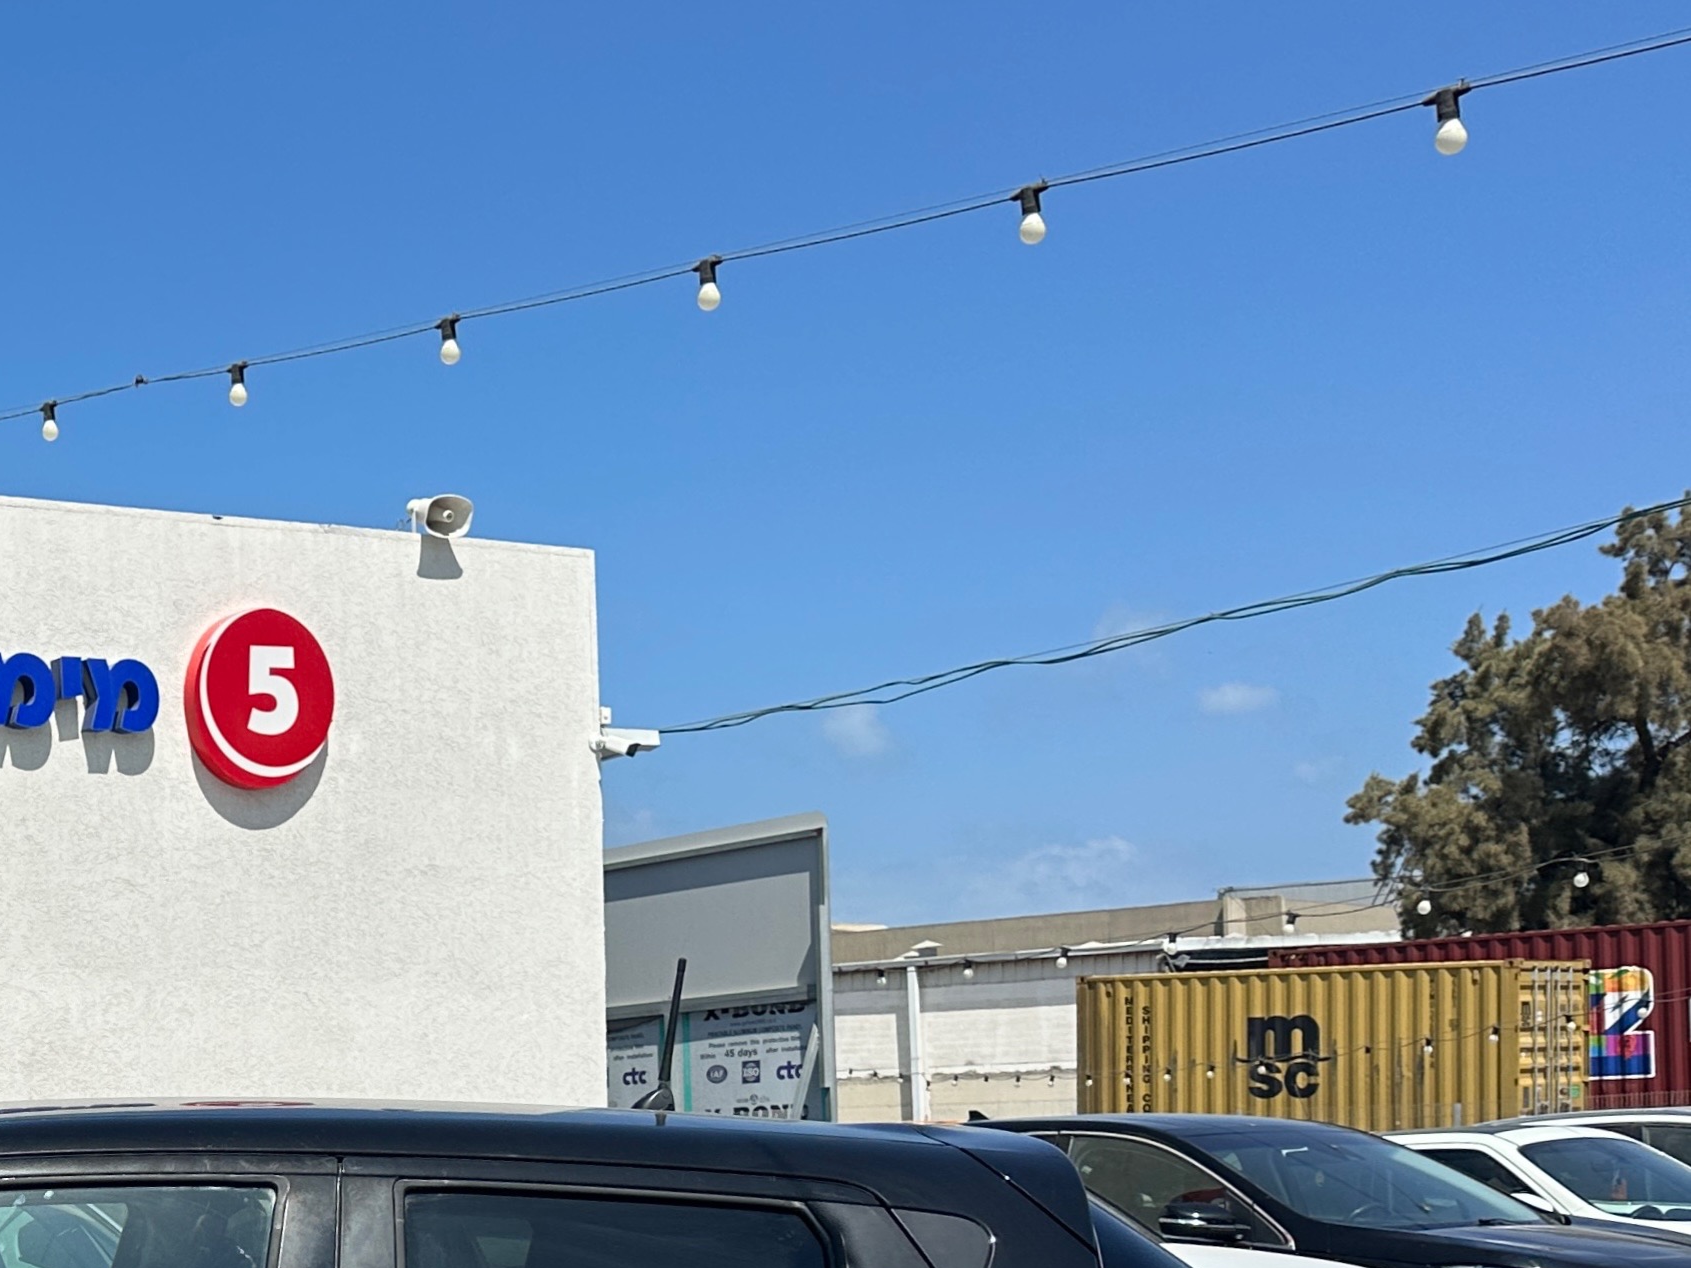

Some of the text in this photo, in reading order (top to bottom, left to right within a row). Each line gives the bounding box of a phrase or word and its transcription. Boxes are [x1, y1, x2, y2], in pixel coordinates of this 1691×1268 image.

[246, 644, 300, 736] 5
[724, 1048, 735, 1058] 45
[737, 1047, 758, 1059] days
[1142, 1005, 1151, 1084] SHIPPING
[622, 1067, 647, 1086] ctc
